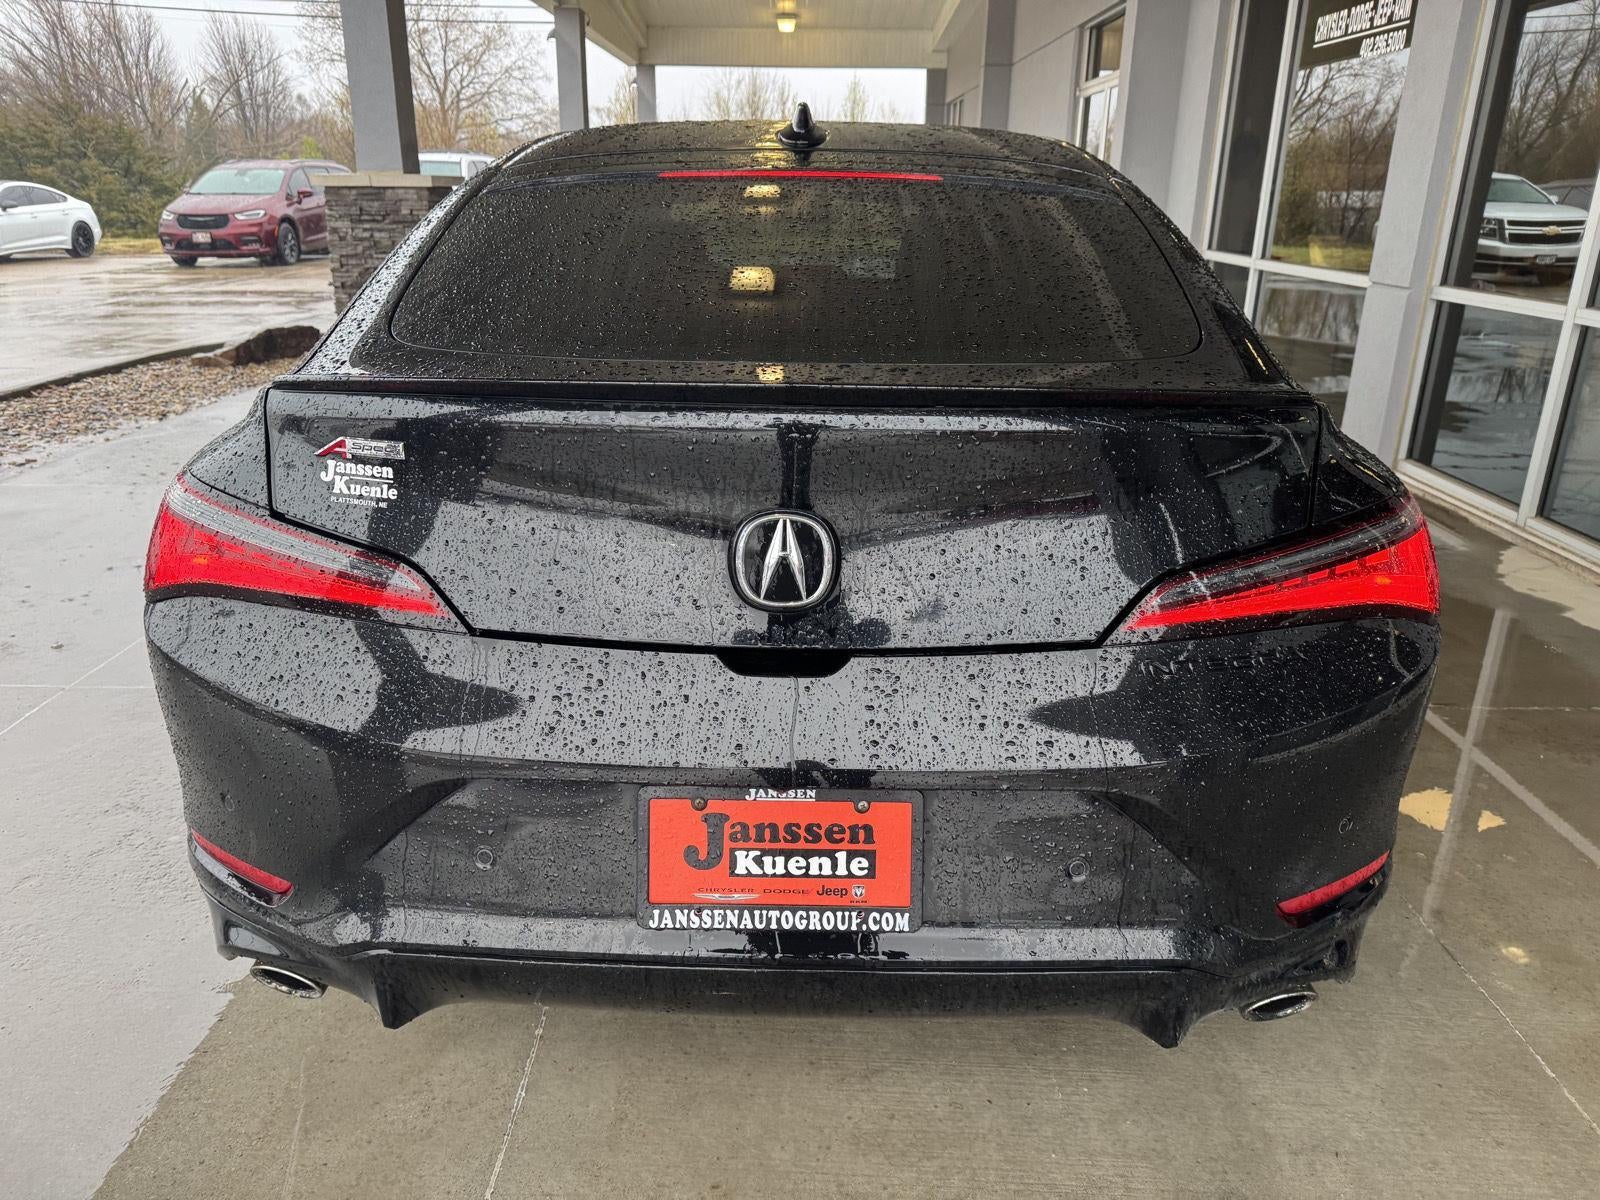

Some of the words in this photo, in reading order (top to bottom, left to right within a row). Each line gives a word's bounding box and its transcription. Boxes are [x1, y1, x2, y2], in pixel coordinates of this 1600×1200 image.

[320, 459, 394, 481] Janssen
[333, 475, 398, 499] Kuenle
[330, 496, 378, 507] PLATTSMOUTH,
[683, 812, 876, 870] Janssen
[733, 849, 870, 876] Kuenle
[816, 884, 848, 898] Jeep
[648, 908, 910, 932] JANSSENAUTOGROUP.COM
